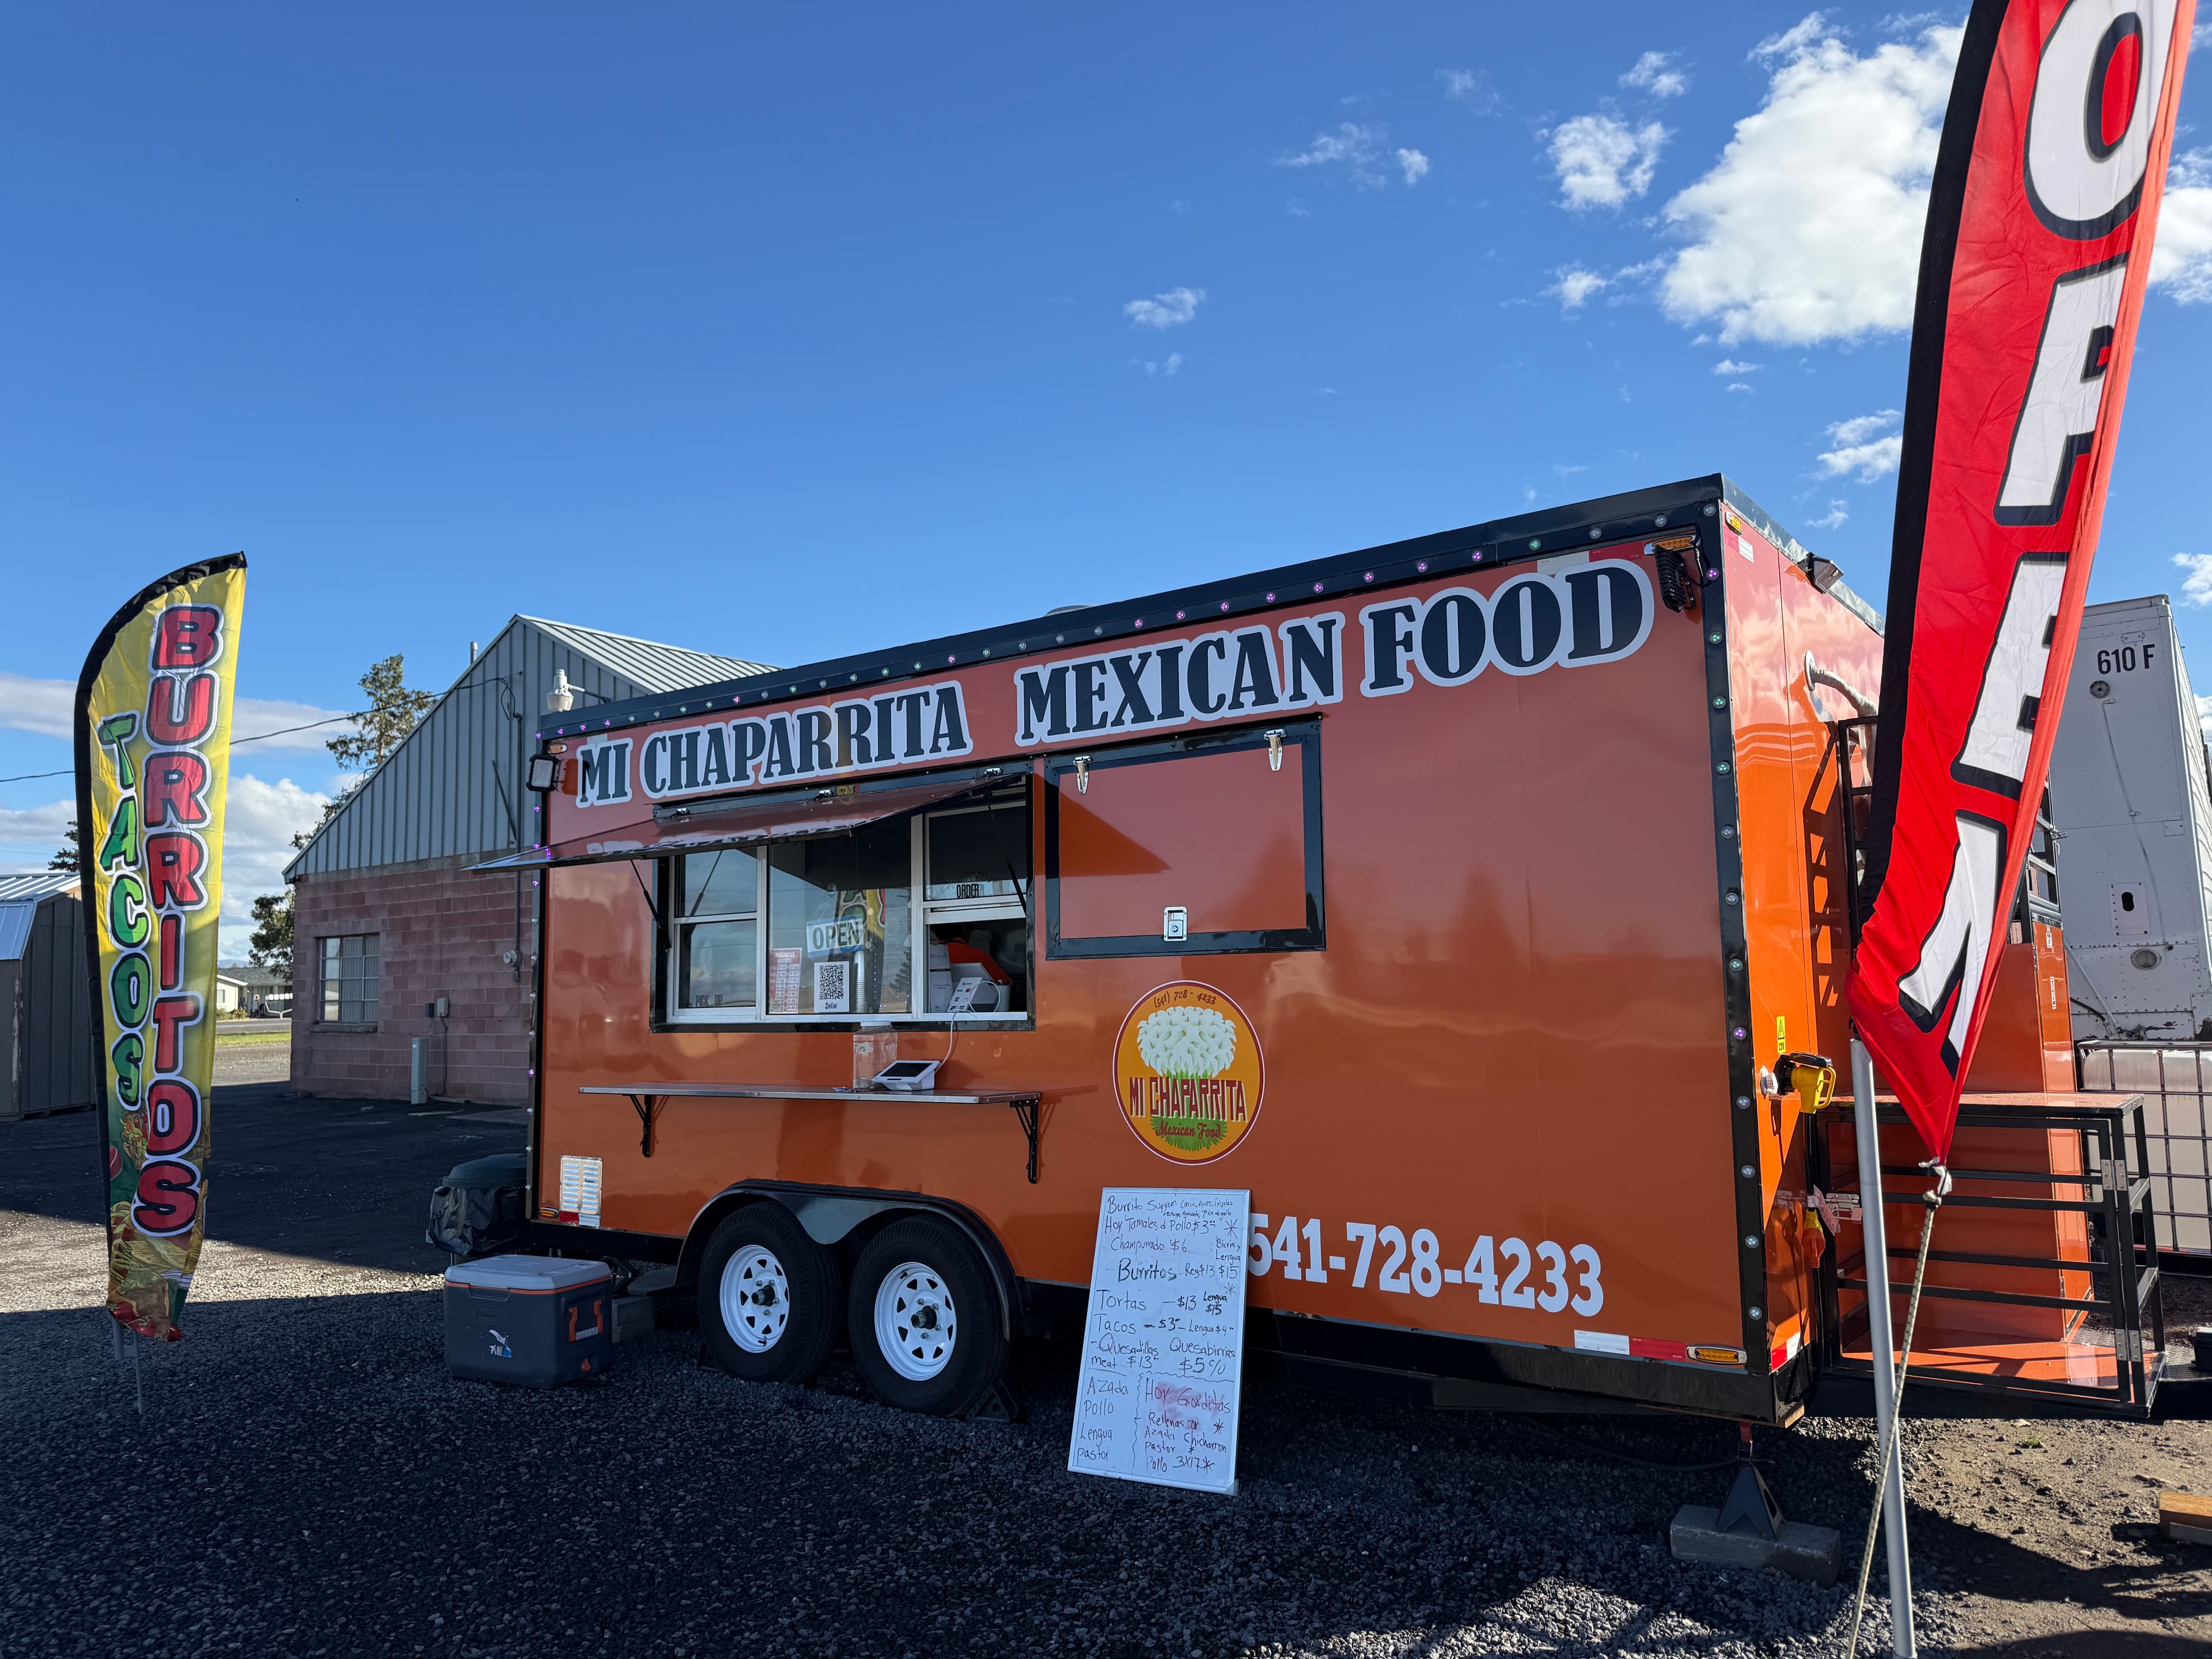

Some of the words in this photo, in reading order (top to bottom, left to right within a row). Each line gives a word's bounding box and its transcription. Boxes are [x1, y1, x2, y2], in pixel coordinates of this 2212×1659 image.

[2097, 646, 2136, 675] 610
[2142, 643, 2156, 669] F
[579, 741, 631, 805] MI
[643, 684, 969, 794] CHAPARRITA
[1020, 616, 1339, 740] MEXICAN
[1366, 564, 1645, 690] FOOD
[956, 883, 979, 898] ORDER
[98, 711, 151, 1111] TACOS
[136, 602, 222, 1235] BURRITOS
[812, 921, 860, 950] OPEN
[1154, 990, 1170, 1008] (541)
[1174, 989, 1187, 1001] 728
[1196, 993, 1217, 1005] 4233
[1129, 1077, 1145, 1118] MI
[1150, 1077, 1248, 1123] CHAPARRITA
[1156, 1120, 1195, 1137] Mexican
[1197, 1123, 1221, 1139] Food
[1107, 1195, 1142, 1214] Burrito
[1105, 1215, 1123, 1234] Hoy
[1111, 1234, 1165, 1255] Champurrado
[1215, 1238, 1235, 1248] Birria
[1215, 1250, 1241, 1266] Lengua
[1248, 1213, 1604, 1317] 541-728-4233
[1118, 1257, 1177, 1283] Burritos
[1218, 1266, 1240, 1279] $15
[1096, 1289, 1147, 1310] Tortas
[1203, 1290, 1227, 1304] Lengua
[1094, 1313, 1136, 1334] Tacos
[1188, 1319, 1214, 1335] Lengua
[1098, 1332, 1159, 1356] Quesadillas
[1145, 1378, 1171, 1406] Hoy
[1081, 1423, 1112, 1446] Lengua
